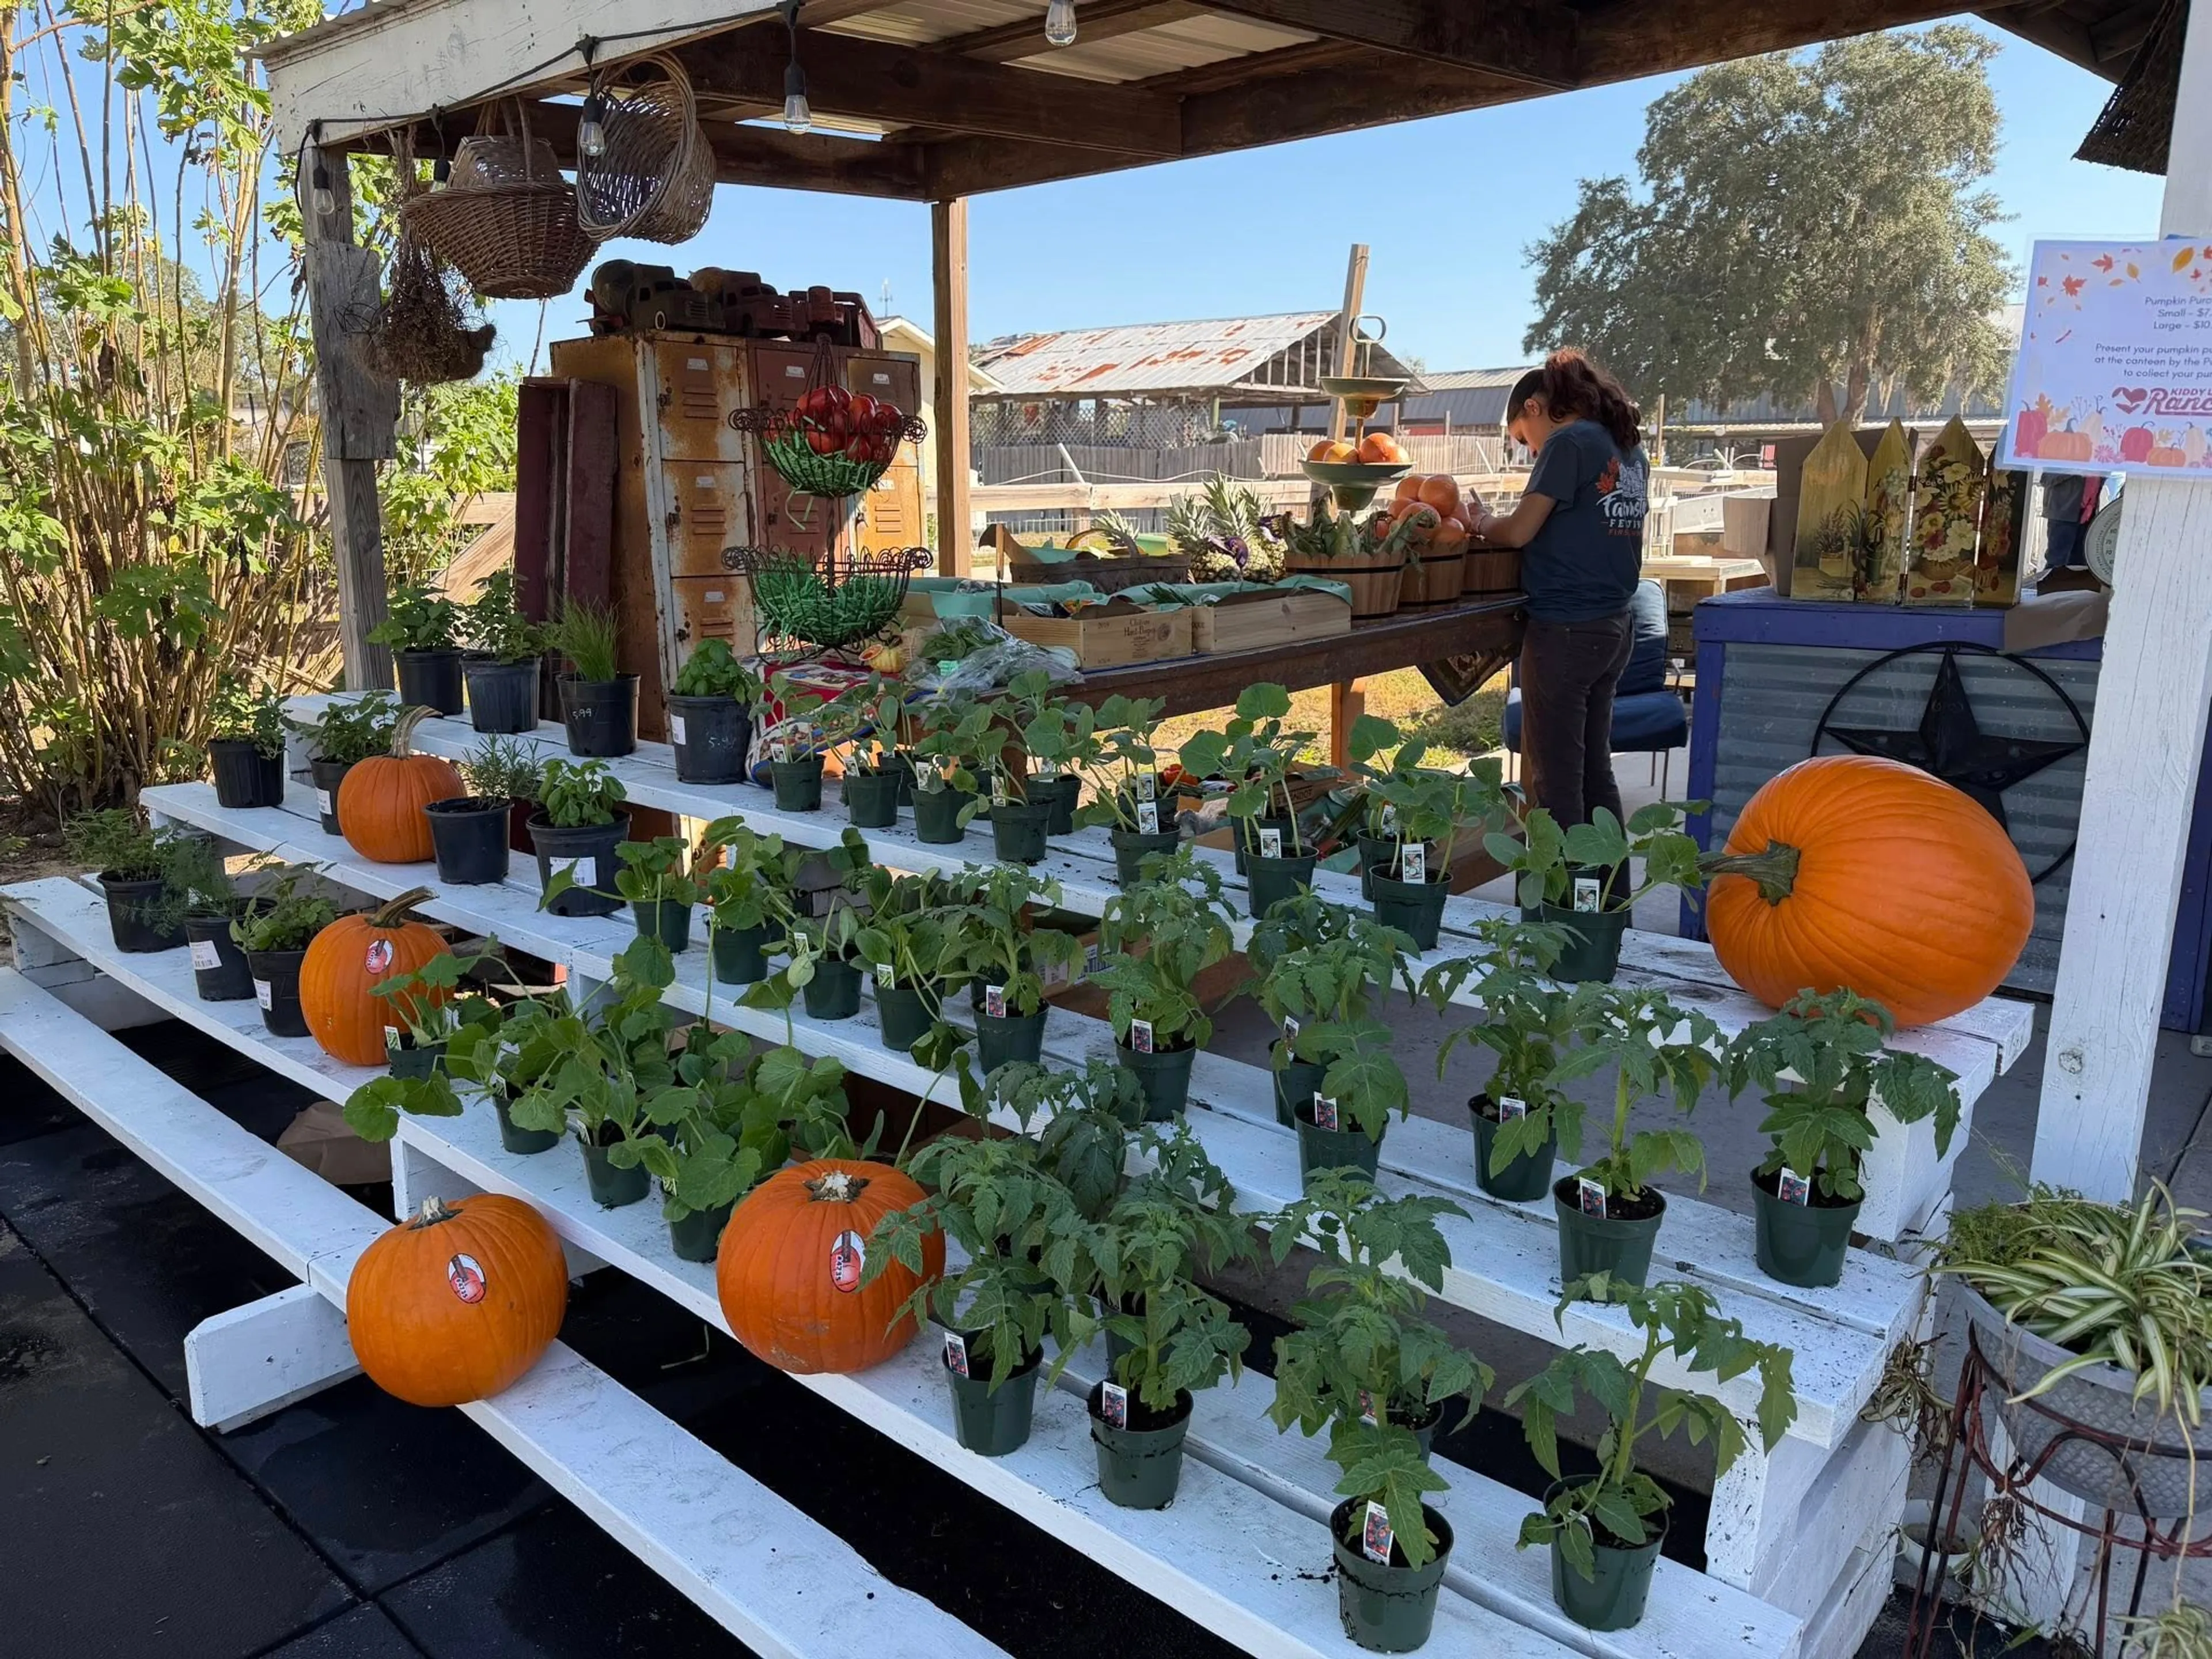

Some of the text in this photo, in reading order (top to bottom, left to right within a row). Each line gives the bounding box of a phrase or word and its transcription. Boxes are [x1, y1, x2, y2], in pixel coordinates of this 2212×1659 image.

[2145, 296, 2187, 307] Pumpkin
[2157, 308, 2186, 317] Small
[2154, 321, 2181, 332] Large
[2095, 343, 2131, 352] Present
[2134, 346, 2154, 355] your
[2157, 344, 2199, 356] pumpkin
[2108, 355, 2123, 364] the
[2125, 357, 2166, 366] canteen
[2169, 357, 2181, 368] by
[2184, 357, 2200, 366] the
[2136, 369, 2169, 377] collect
[2171, 371, 2194, 380] your
[2171, 388, 2206, 396] KIDDY
